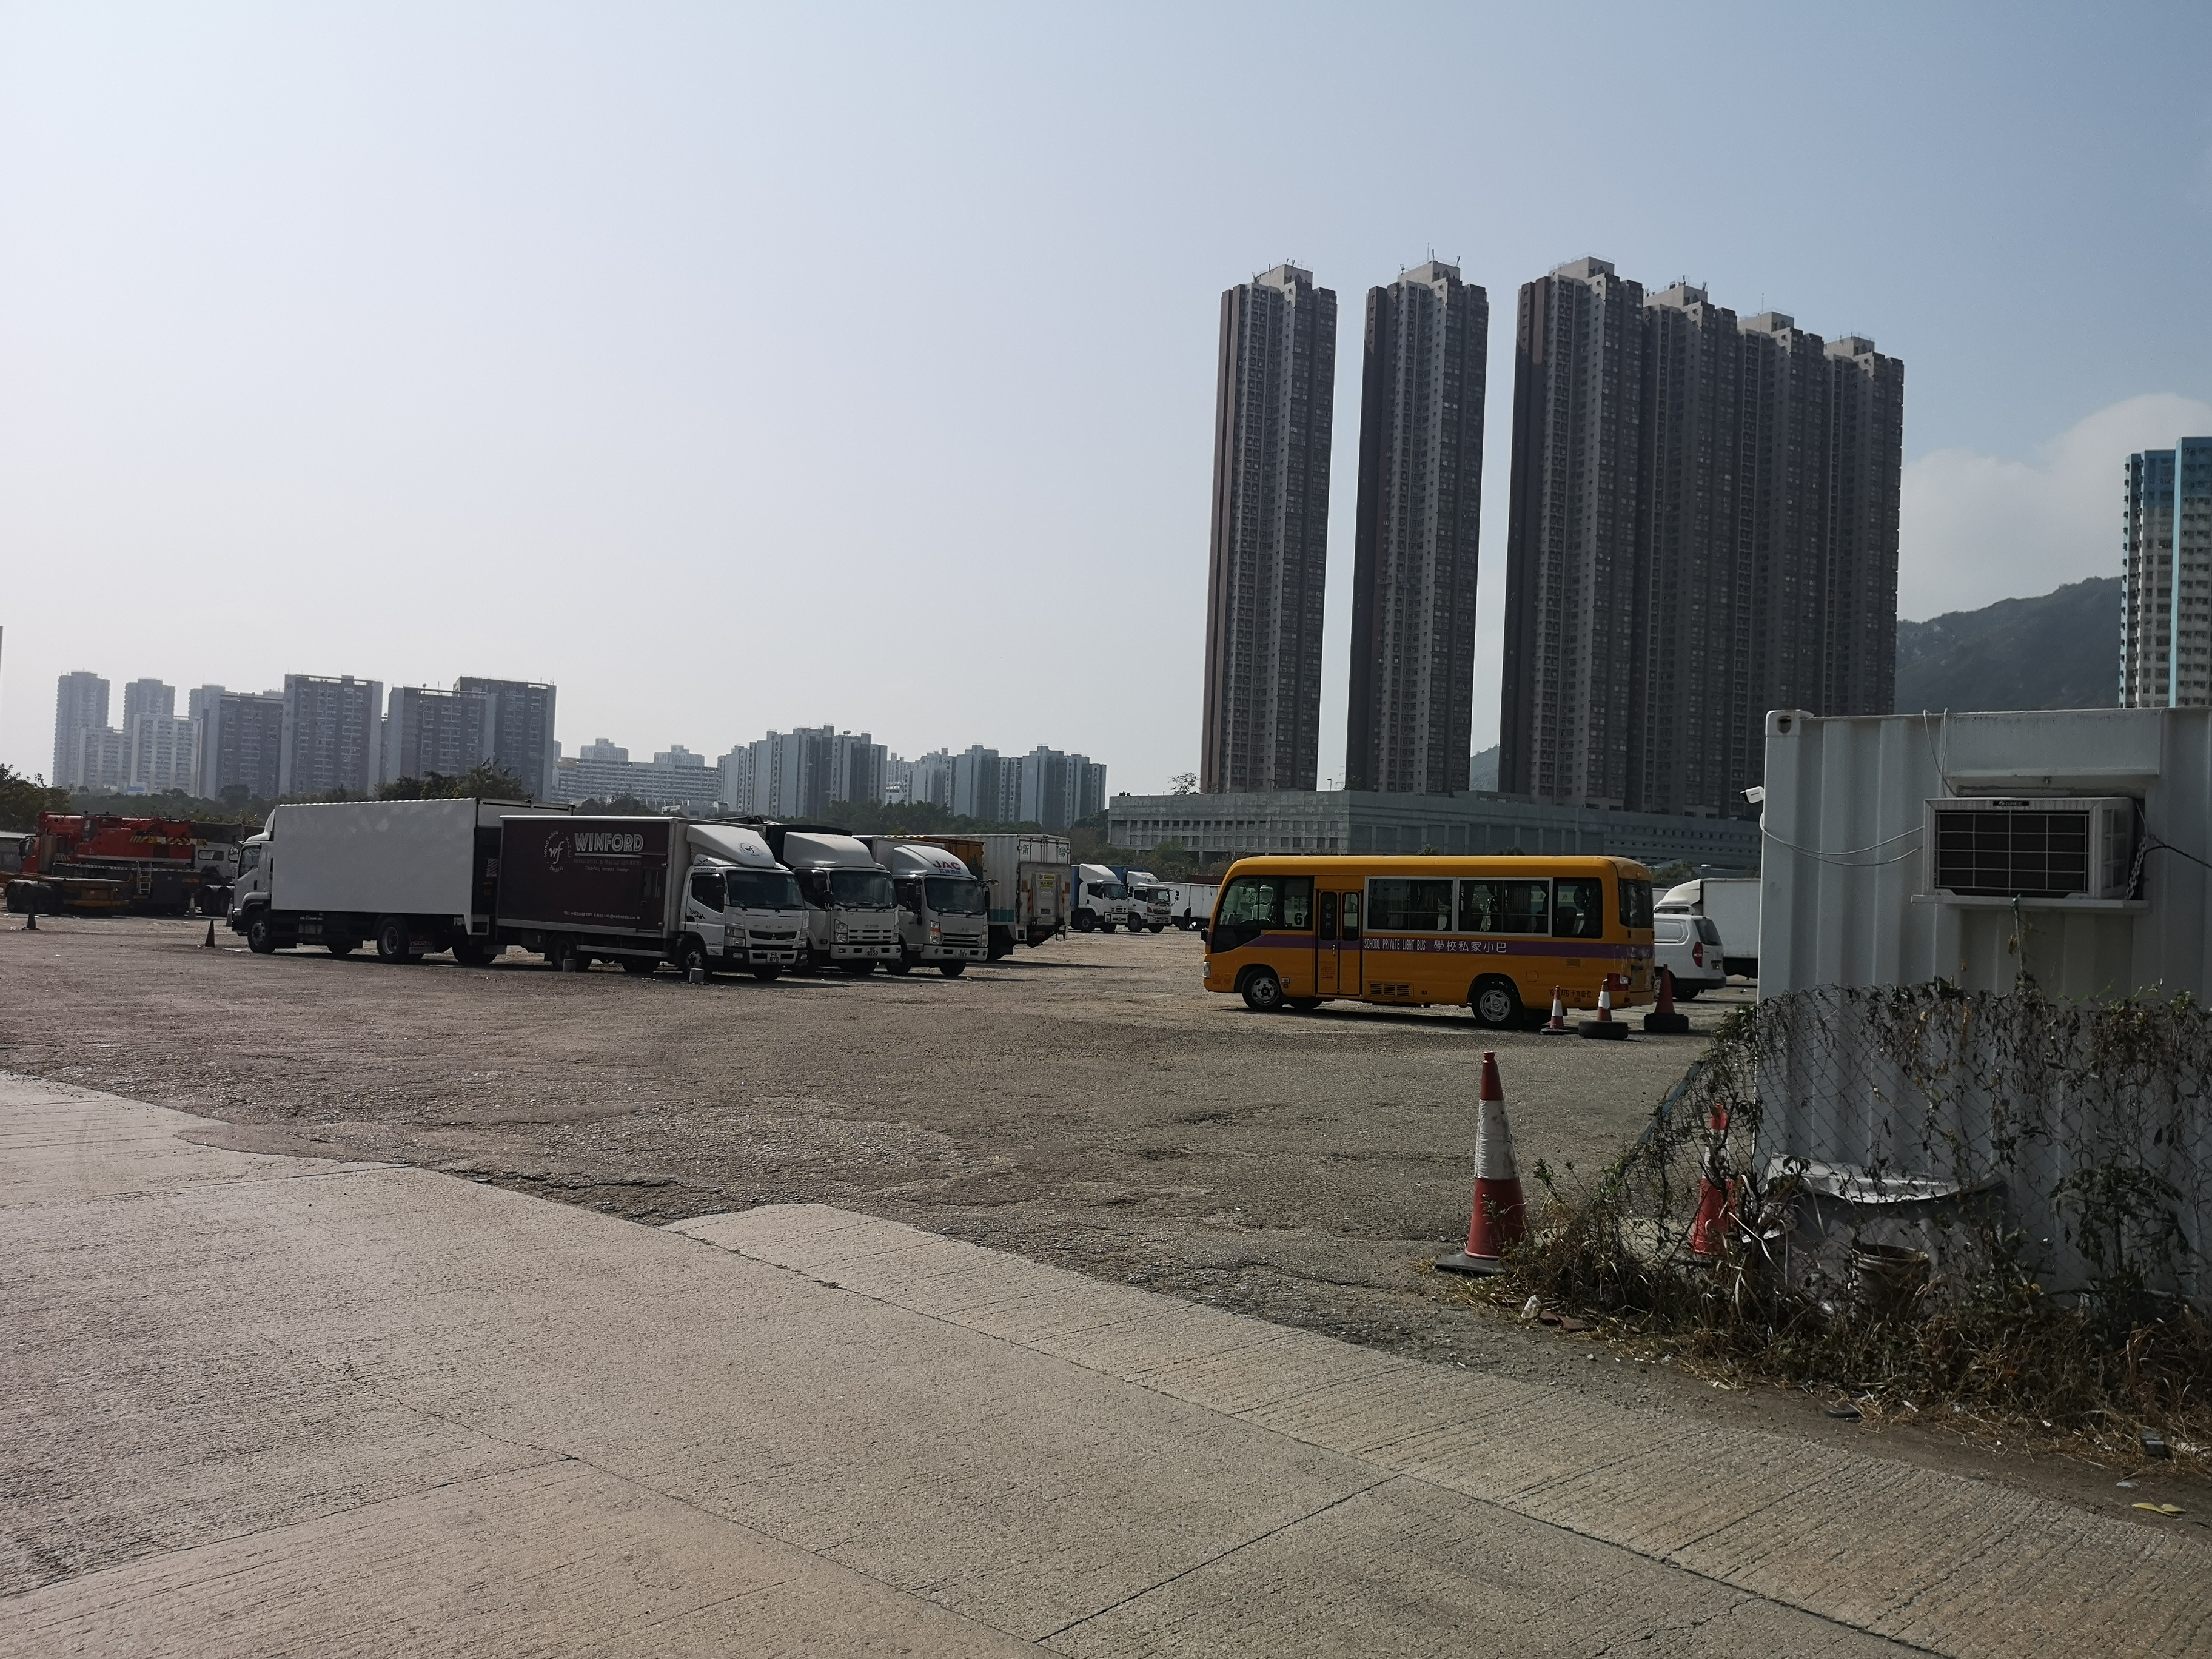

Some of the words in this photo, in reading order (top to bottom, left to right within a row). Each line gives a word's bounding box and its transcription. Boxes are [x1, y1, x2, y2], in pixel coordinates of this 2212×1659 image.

[548, 830, 559, 840] KONG
[574, 833, 644, 852] WINFORD
[933, 860, 962, 870] JAC
[1294, 913, 1303, 925] 6
[1364, 938, 1381, 949] SCHOOL
[1382, 939, 1400, 950] PRIVATE
[1402, 939, 1415, 950] LIGHT
[1417, 939, 1426, 950] BUS
[1433, 940, 1507, 953] 學校私家小巴
[1570, 989, 1592, 998] 十九座位
